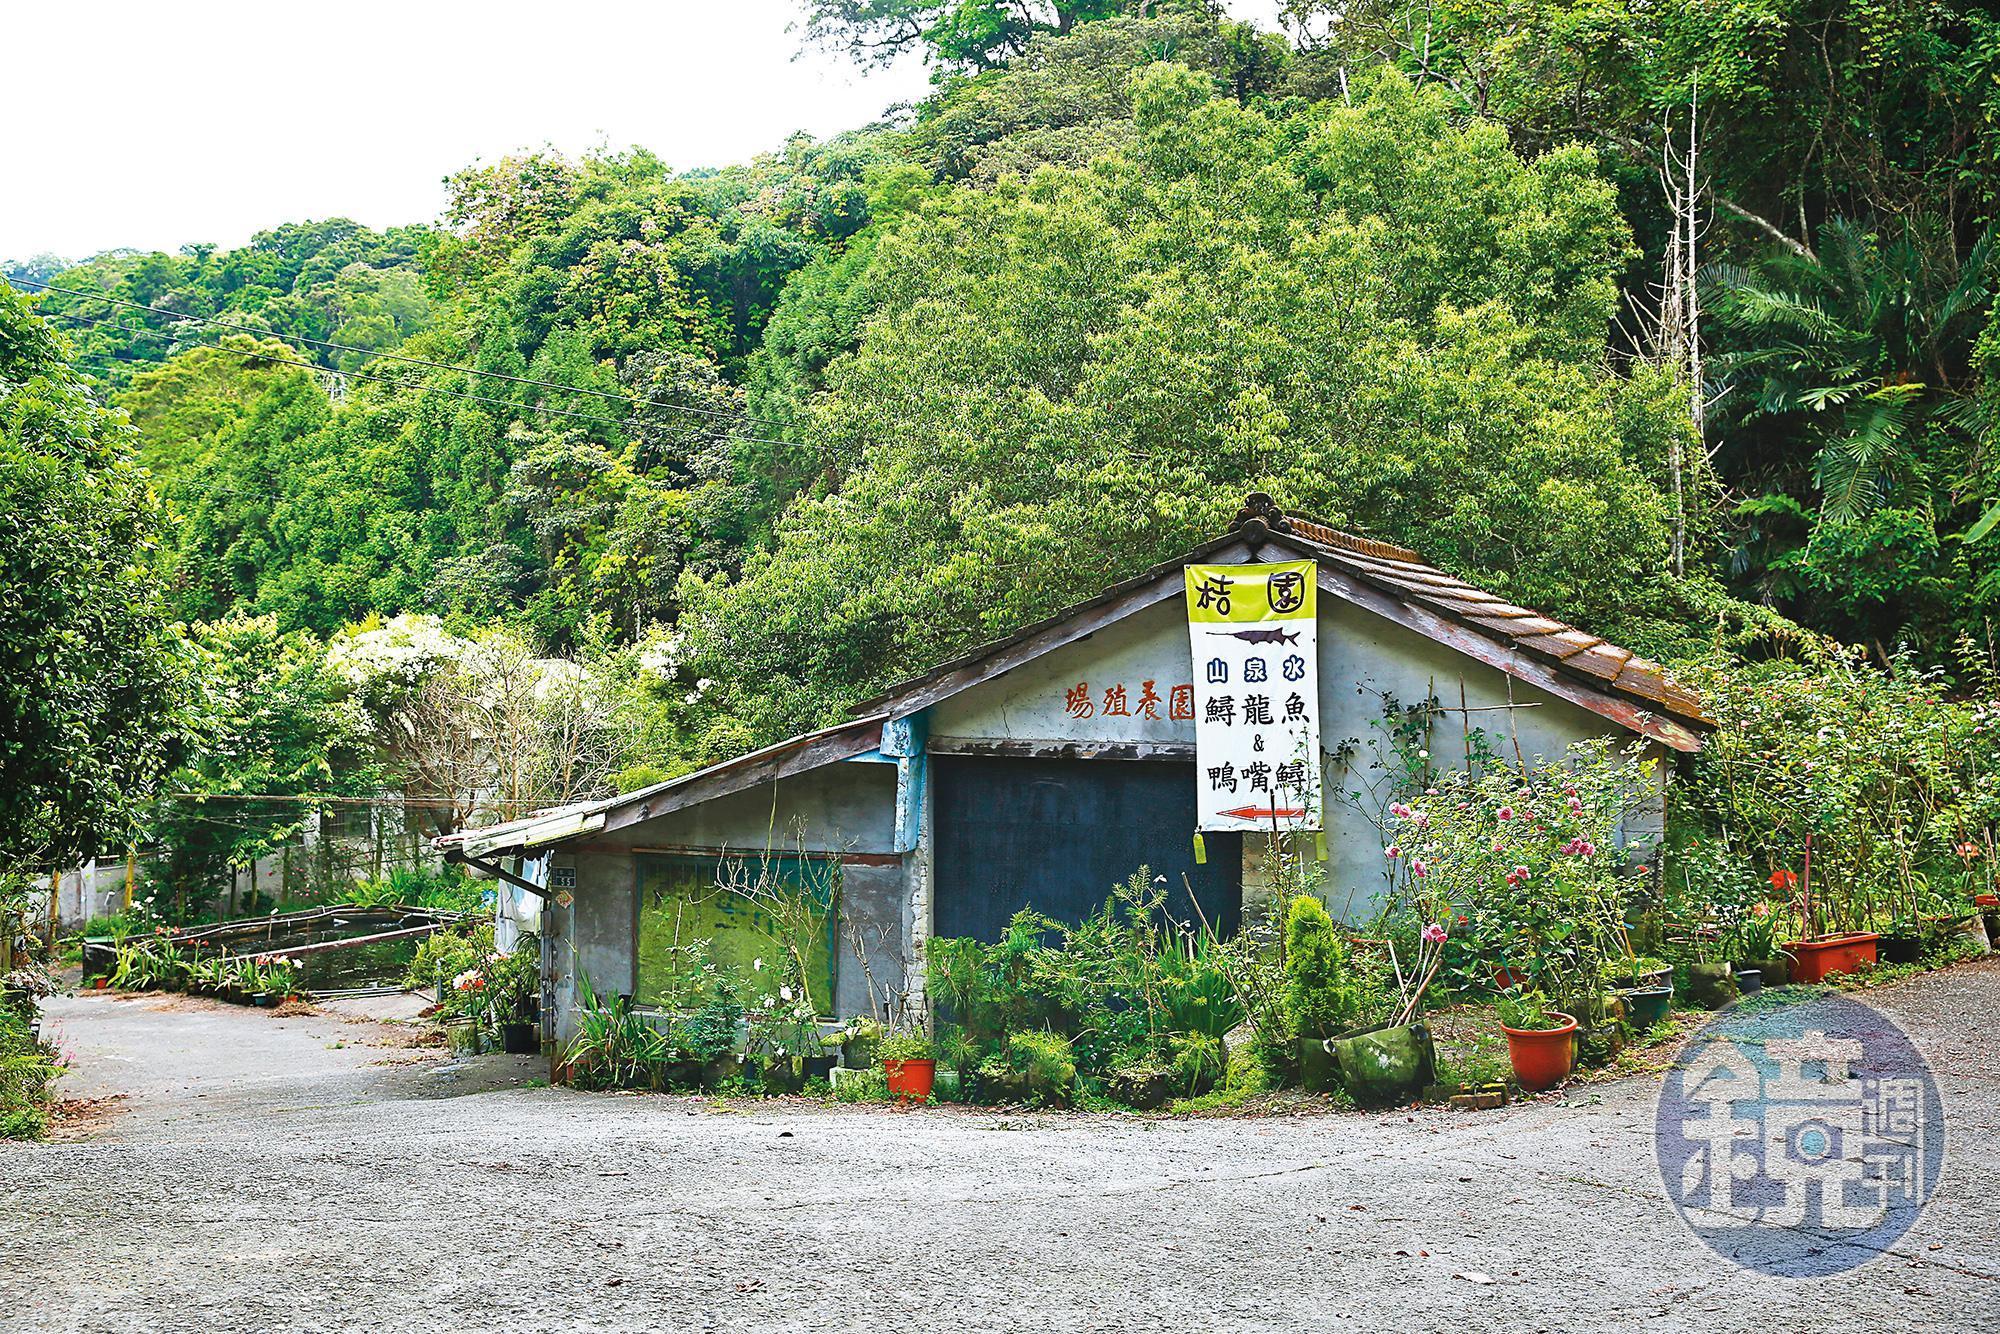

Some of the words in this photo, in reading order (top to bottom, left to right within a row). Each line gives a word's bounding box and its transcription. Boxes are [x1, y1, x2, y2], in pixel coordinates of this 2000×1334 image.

[1195, 571, 1305, 615] 桔園
[1206, 654, 1305, 684] 山泉水
[1204, 692, 1310, 727] 鱘龍魚
[1253, 733, 1264, 752] &
[1207, 761, 1307, 795] 鴨嘴鱘
